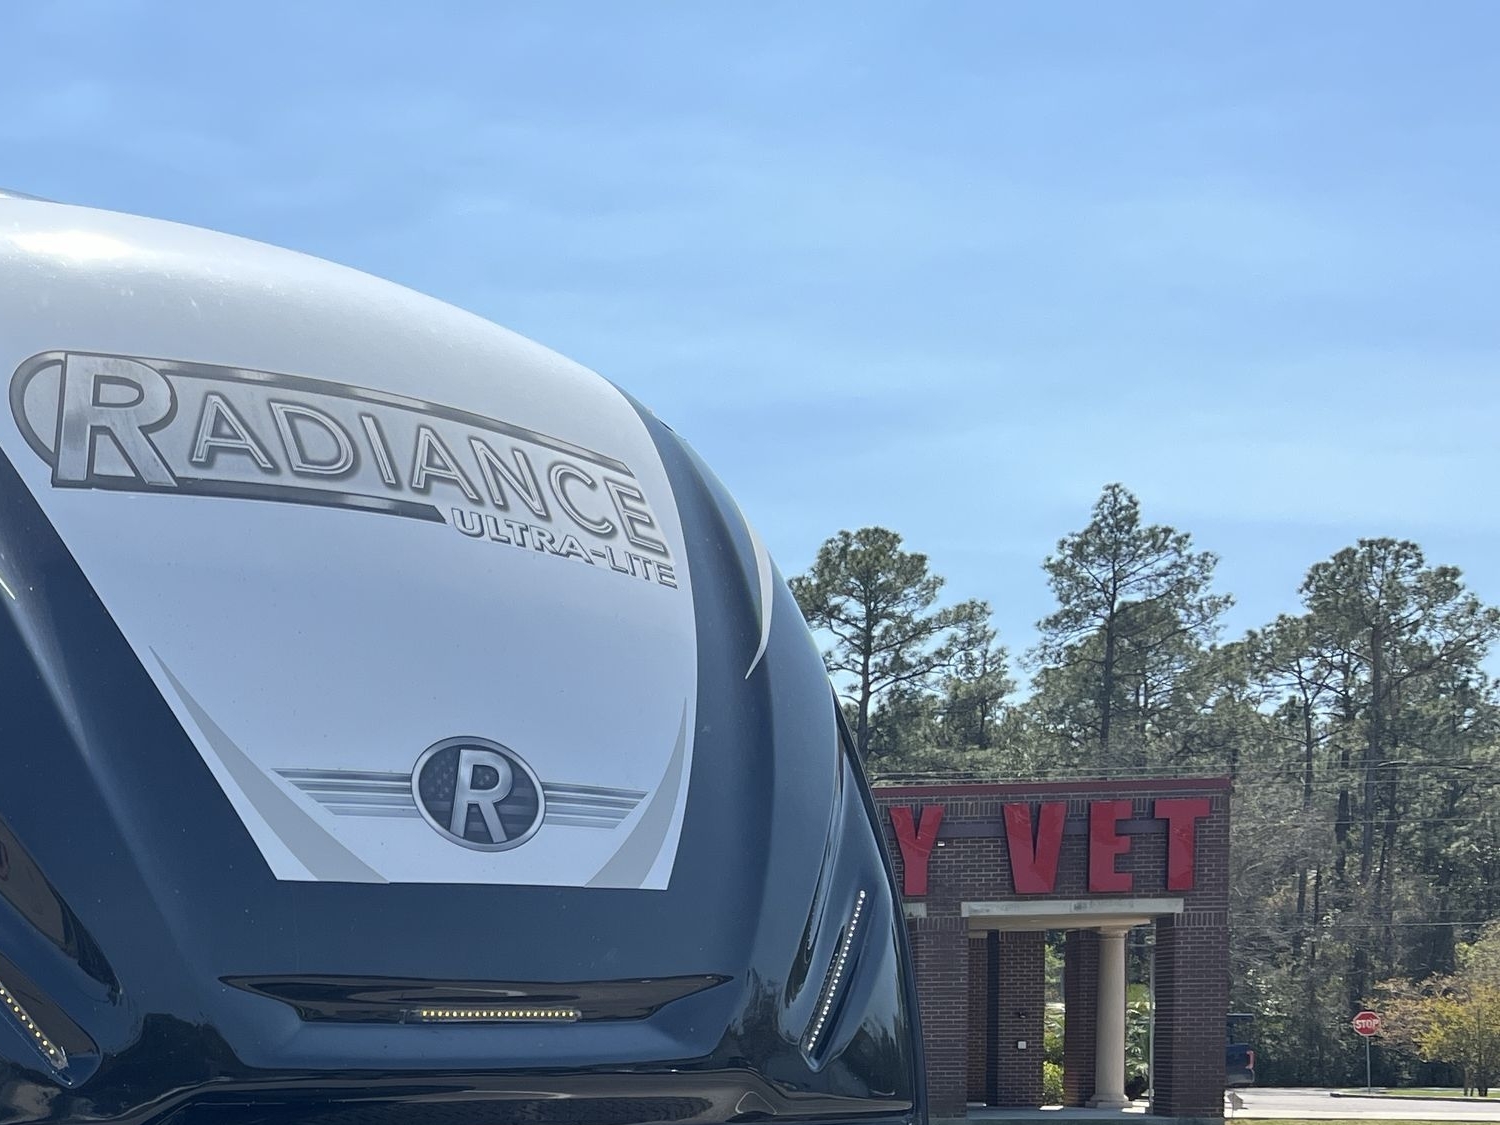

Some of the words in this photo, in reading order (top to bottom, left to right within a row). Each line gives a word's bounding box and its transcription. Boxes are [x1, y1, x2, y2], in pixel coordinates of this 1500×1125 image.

[53, 352, 671, 557] RADIANCE
[450, 506, 679, 589] ULTRA-LITE
[449, 748, 512, 844] R
[1003, 799, 1210, 894] VET
[1355, 1019, 1379, 1029] STOP
